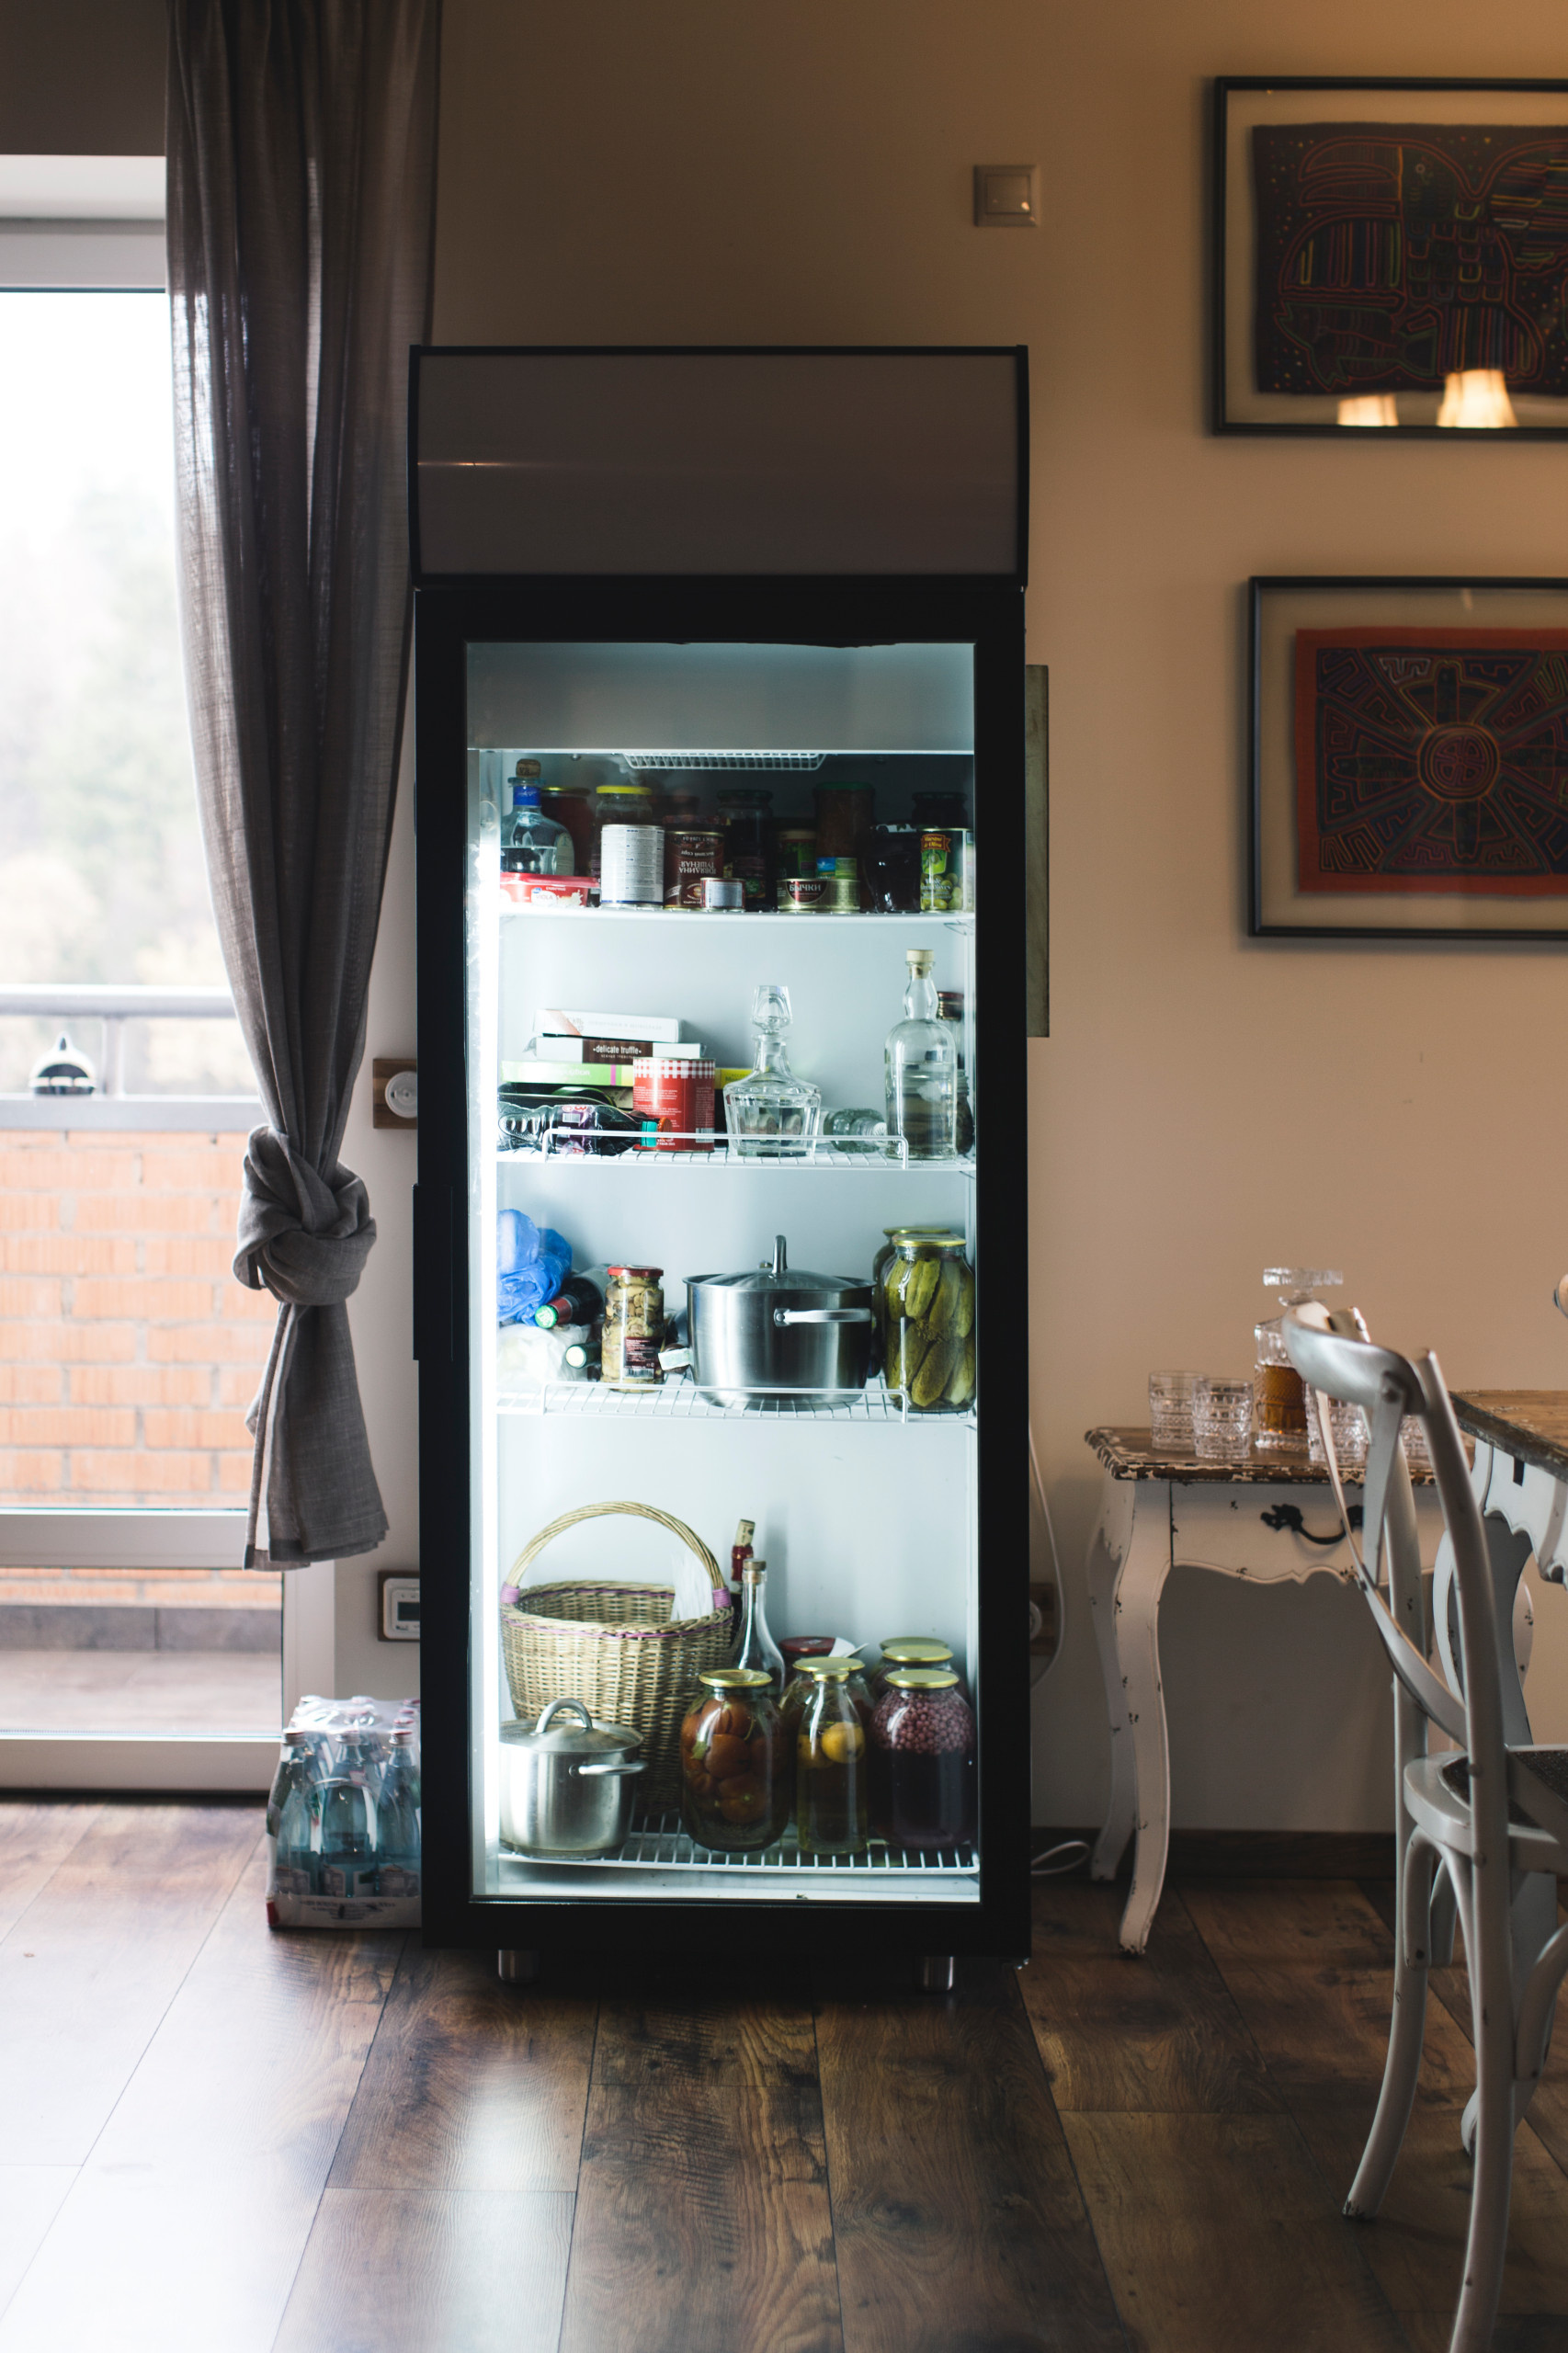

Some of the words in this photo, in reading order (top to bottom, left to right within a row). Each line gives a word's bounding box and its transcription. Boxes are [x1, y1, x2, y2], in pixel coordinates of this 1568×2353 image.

[789, 883, 822, 892] БЫЧКИ
[596, 1045, 619, 1053] delicate
[620, 1046, 639, 1055] truffle
